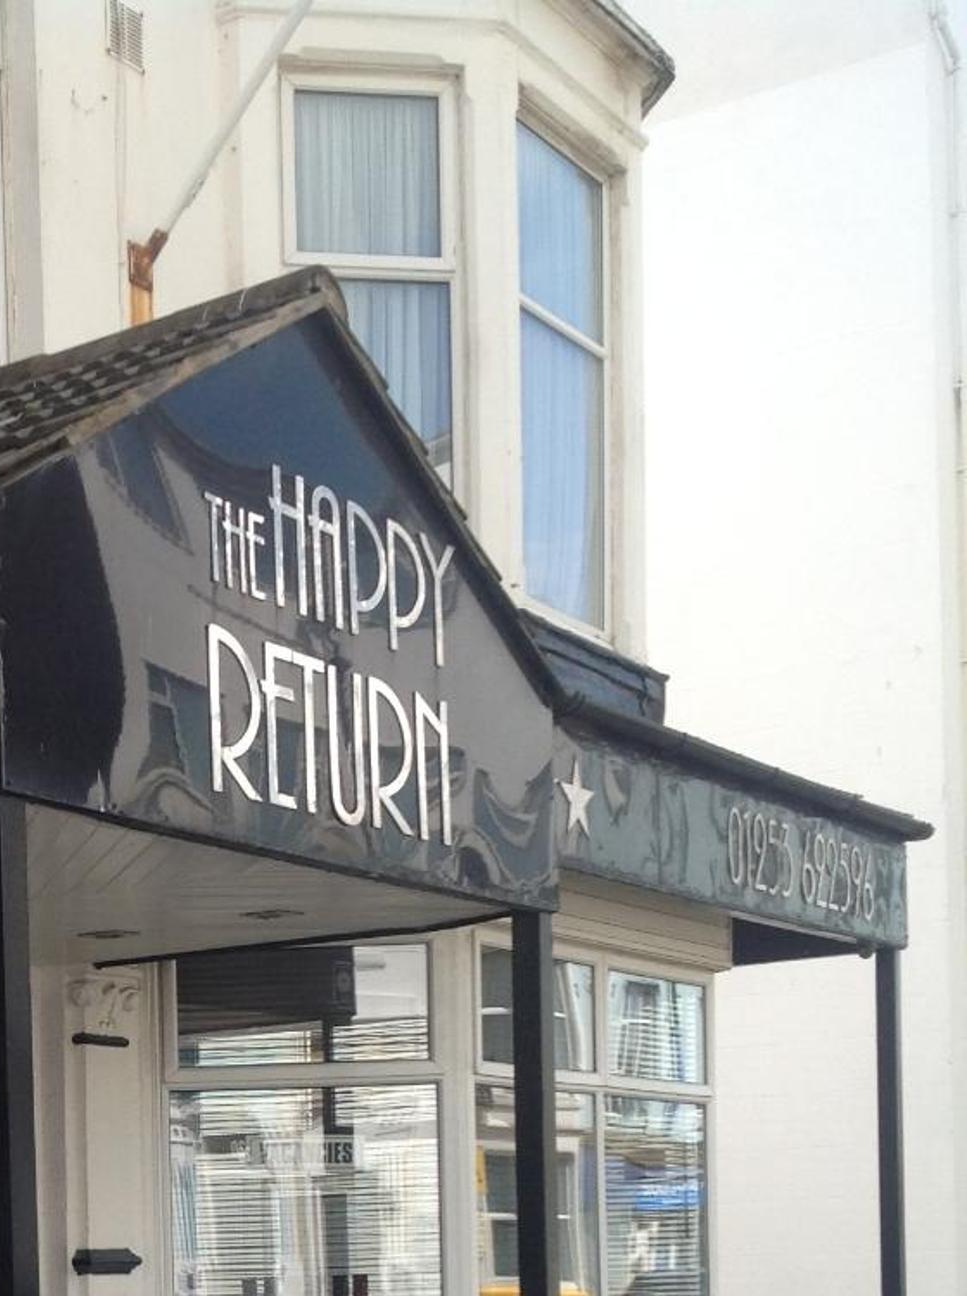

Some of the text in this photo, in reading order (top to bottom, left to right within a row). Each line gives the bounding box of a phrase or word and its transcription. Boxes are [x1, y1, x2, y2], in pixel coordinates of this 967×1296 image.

[204, 464, 455, 667] THE HAPPY
[207, 623, 453, 846] RETURN
[728, 807, 875, 920] 01253 622596
